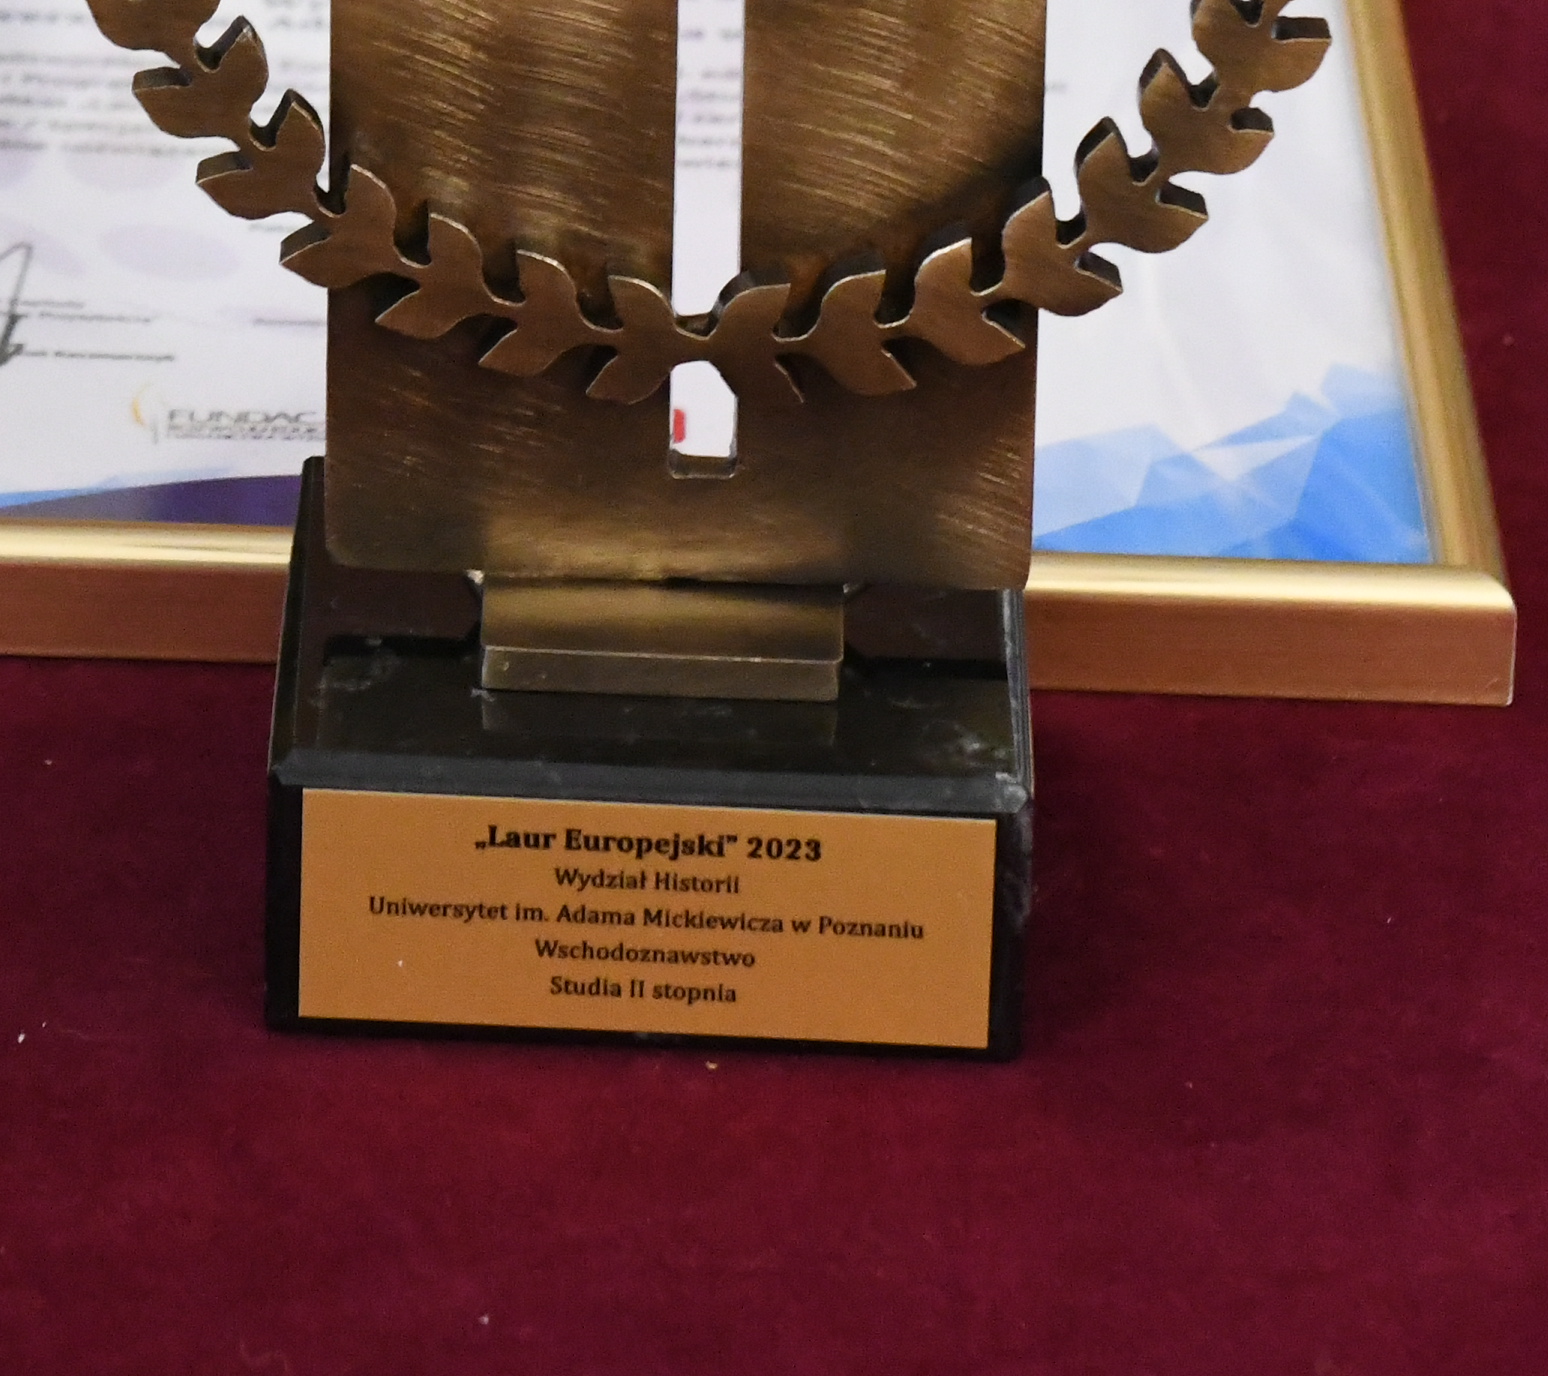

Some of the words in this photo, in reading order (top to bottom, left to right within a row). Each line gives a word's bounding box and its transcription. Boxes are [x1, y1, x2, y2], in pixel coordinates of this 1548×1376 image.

[747, 836, 821, 863] 2023
[554, 866, 648, 893] Wydział
[654, 871, 739, 894] Historii
[369, 895, 508, 924] Uniwersytet
[515, 902, 549, 923] im.
[556, 903, 636, 927] Adama
[643, 907, 784, 934] Mickiewicza
[791, 919, 811, 934] w
[819, 915, 924, 940] Poznaniu
[535, 937, 756, 969] Wschodoznawstwo
[550, 975, 622, 998] Studia
[630, 978, 645, 999] II
[652, 983, 737, 1007] stopnia
